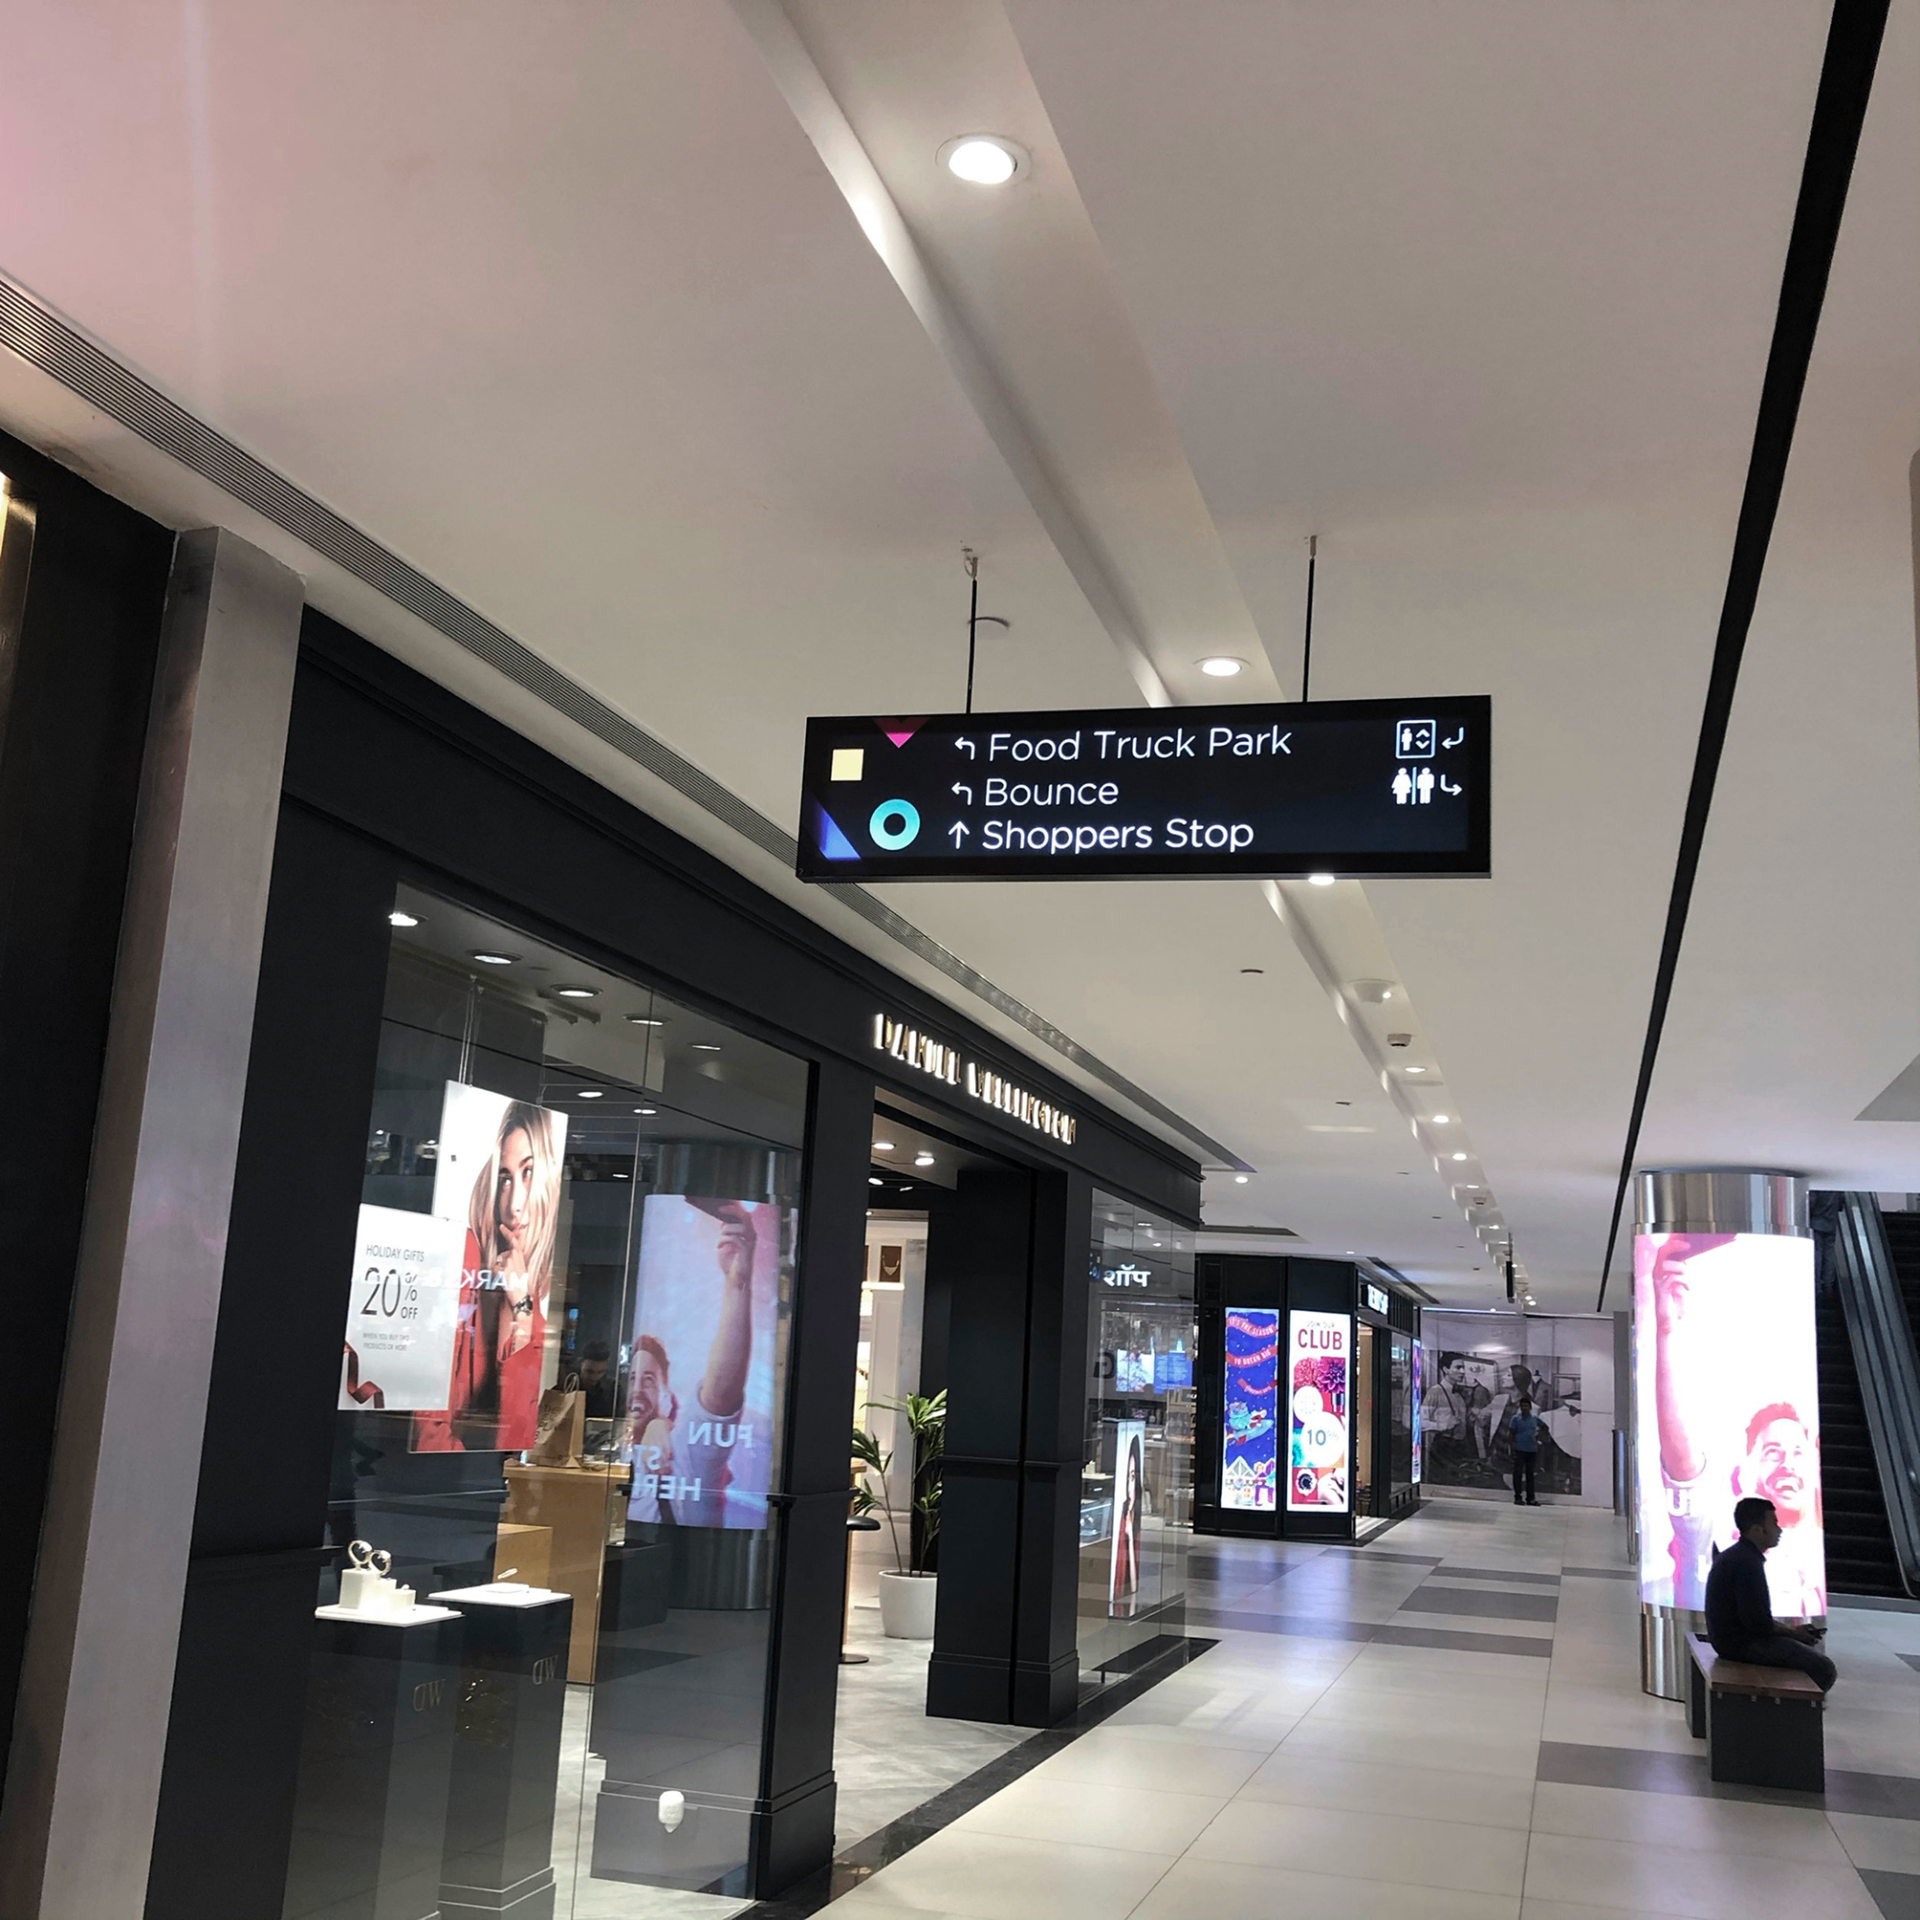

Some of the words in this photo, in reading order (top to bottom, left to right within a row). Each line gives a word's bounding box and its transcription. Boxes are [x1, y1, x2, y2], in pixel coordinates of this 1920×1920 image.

[989, 730, 1080, 762] Food
[1093, 727, 1196, 760] Truck
[1208, 724, 1292, 757] Park
[985, 777, 1119, 807] Bounce
[982, 819, 1153, 855] Shoppers
[1165, 817, 1254, 853] Stop
[366, 1244, 401, 1259] HOLIDAY
[403, 1249, 425, 1262] GIFTS
[1103, 1264, 1151, 1287] शॉप
[401, 1306, 418, 1320] OFF
[1298, 1328, 1342, 1350] CLUB
